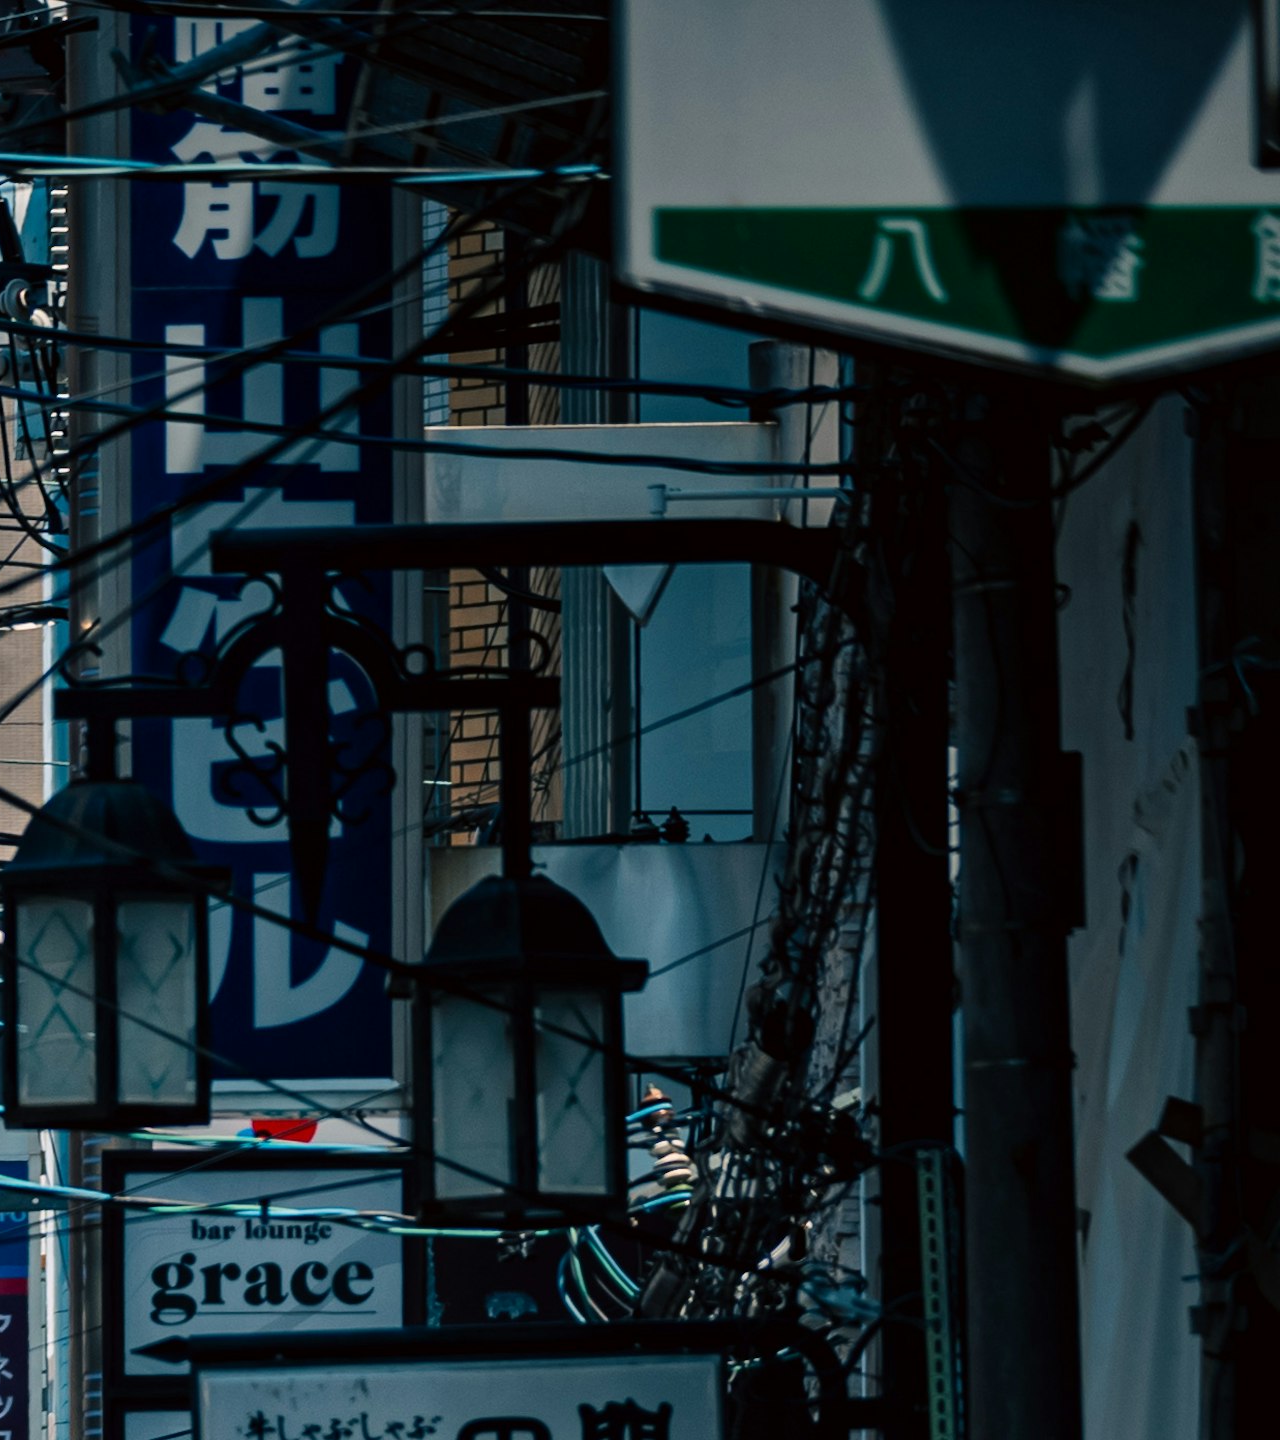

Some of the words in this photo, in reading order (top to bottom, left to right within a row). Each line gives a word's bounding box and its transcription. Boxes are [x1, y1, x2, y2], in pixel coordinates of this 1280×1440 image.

[191, 1219, 236, 1240] bar
[244, 1218, 333, 1246] lounge
[150, 1252, 376, 1326] grace
